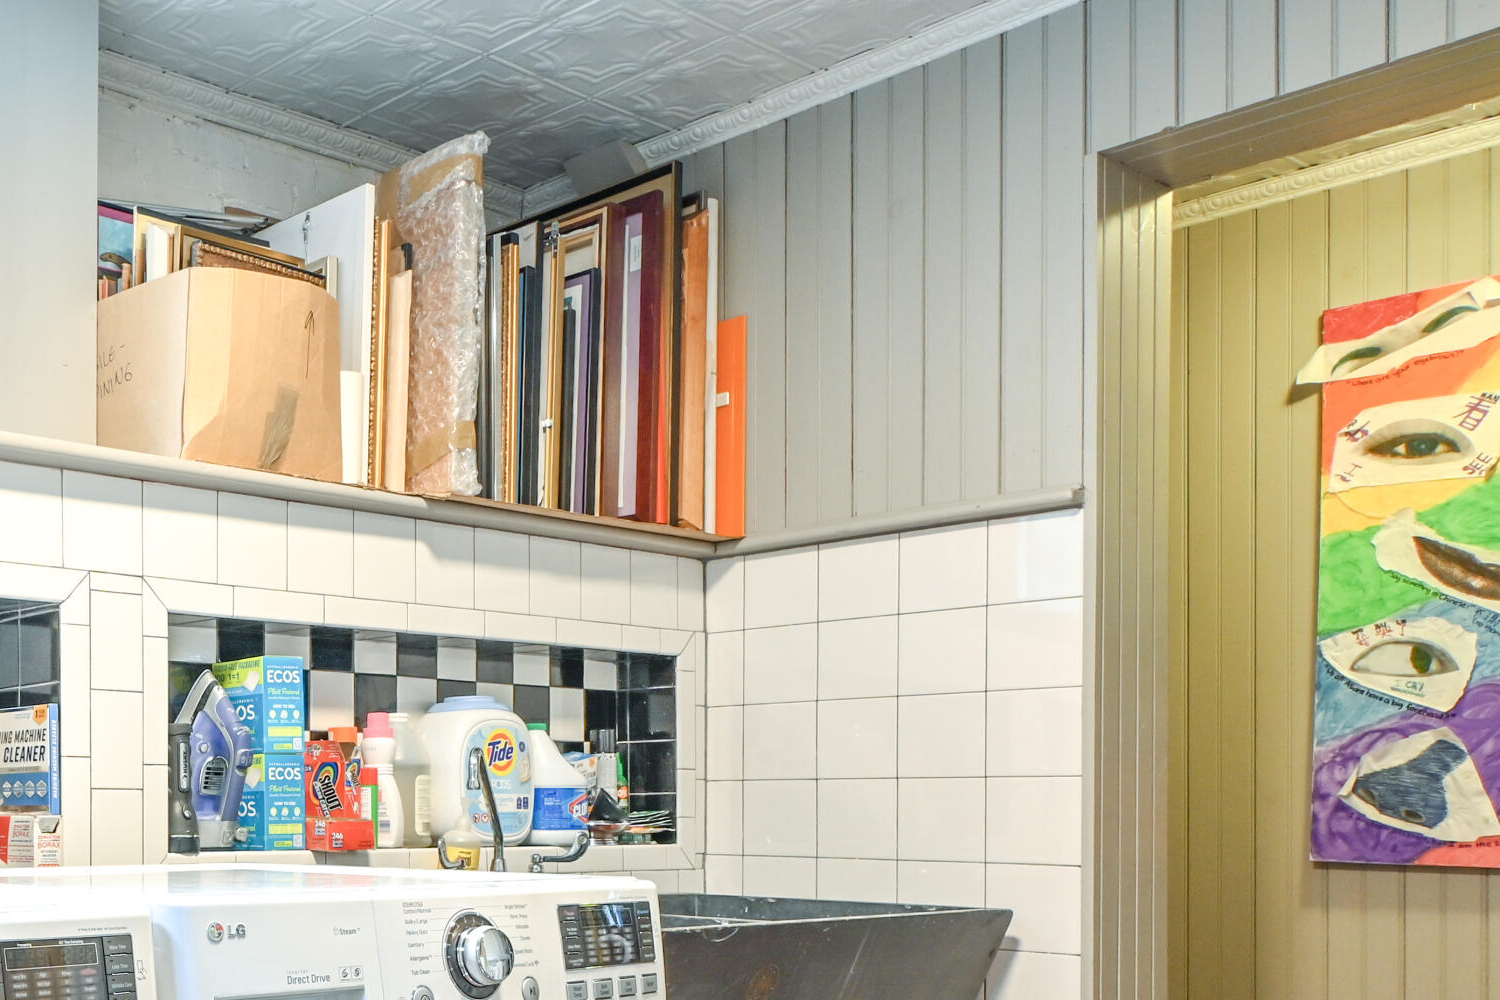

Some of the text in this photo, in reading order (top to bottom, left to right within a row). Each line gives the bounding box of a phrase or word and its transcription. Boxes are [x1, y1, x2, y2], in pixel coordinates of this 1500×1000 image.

[266, 669, 301, 684] ECOS
[235, 704, 256, 721] OS
[13, 728, 47, 744] MACHINE
[3, 745, 46, 763] CLEANER
[488, 740, 515, 767] Tide
[268, 767, 302, 781] ECOS
[318, 774, 344, 812] SHOUT
[237, 800, 257, 817] OS
[37, 841, 60, 849] BORAX
[228, 924, 247, 940] LG
[287, 973, 331, 985] Direct Drive
